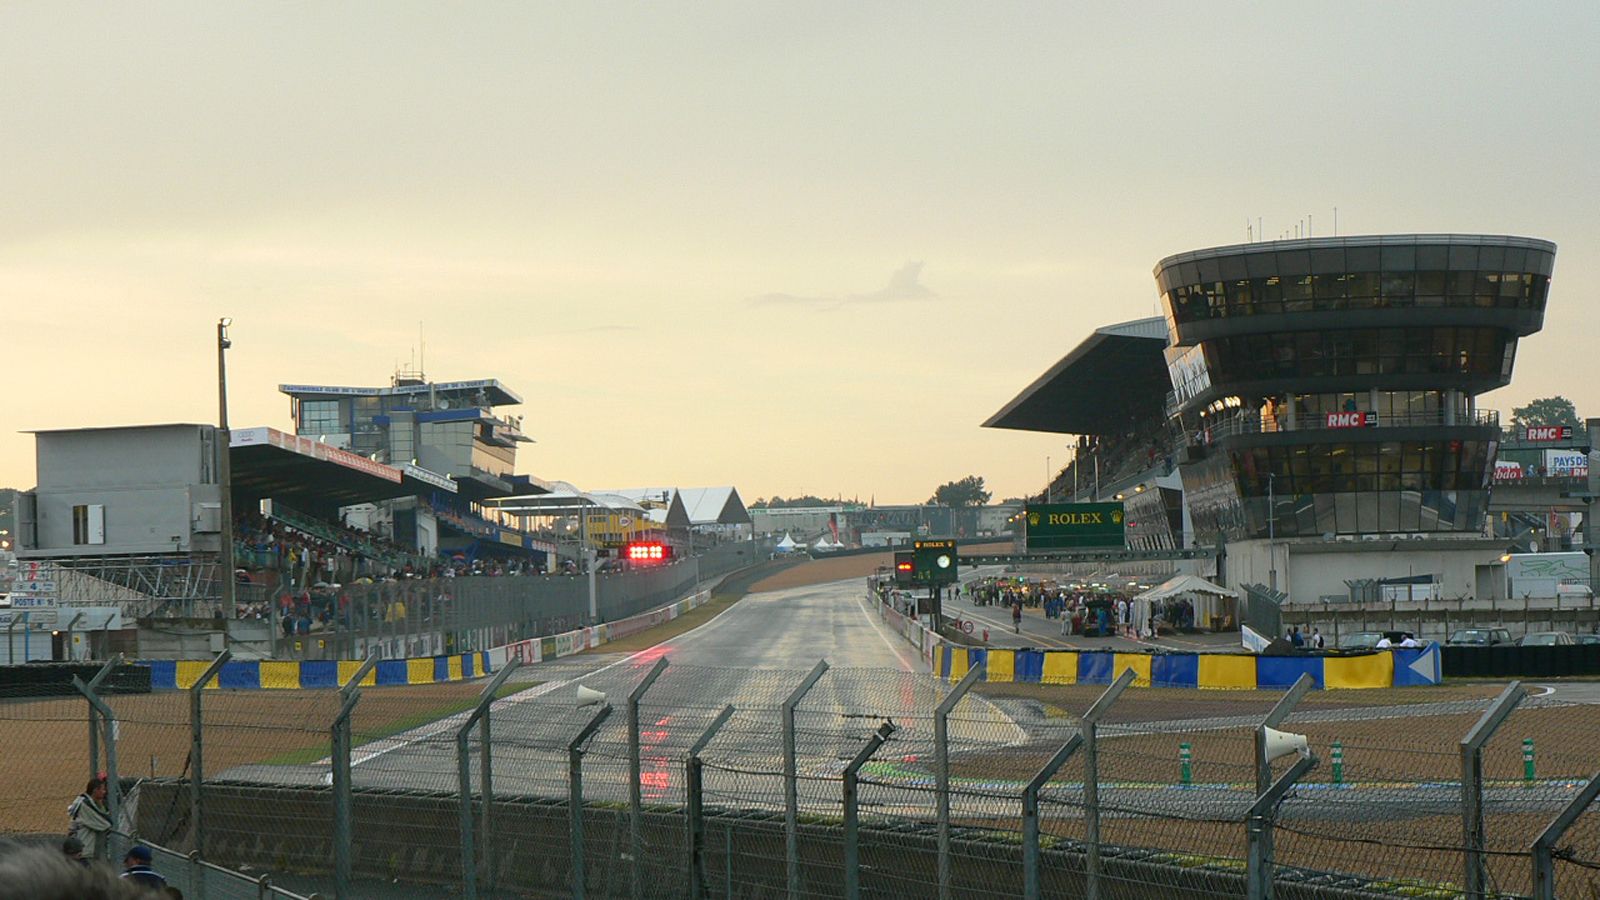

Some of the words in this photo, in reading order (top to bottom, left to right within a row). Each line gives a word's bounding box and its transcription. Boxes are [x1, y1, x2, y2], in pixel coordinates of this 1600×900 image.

[1328, 413, 1359, 427] RMC
[1527, 428, 1557, 440] RMC
[1048, 512, 1102, 525] ROLEX
[14, 598, 35, 606] POSTE
